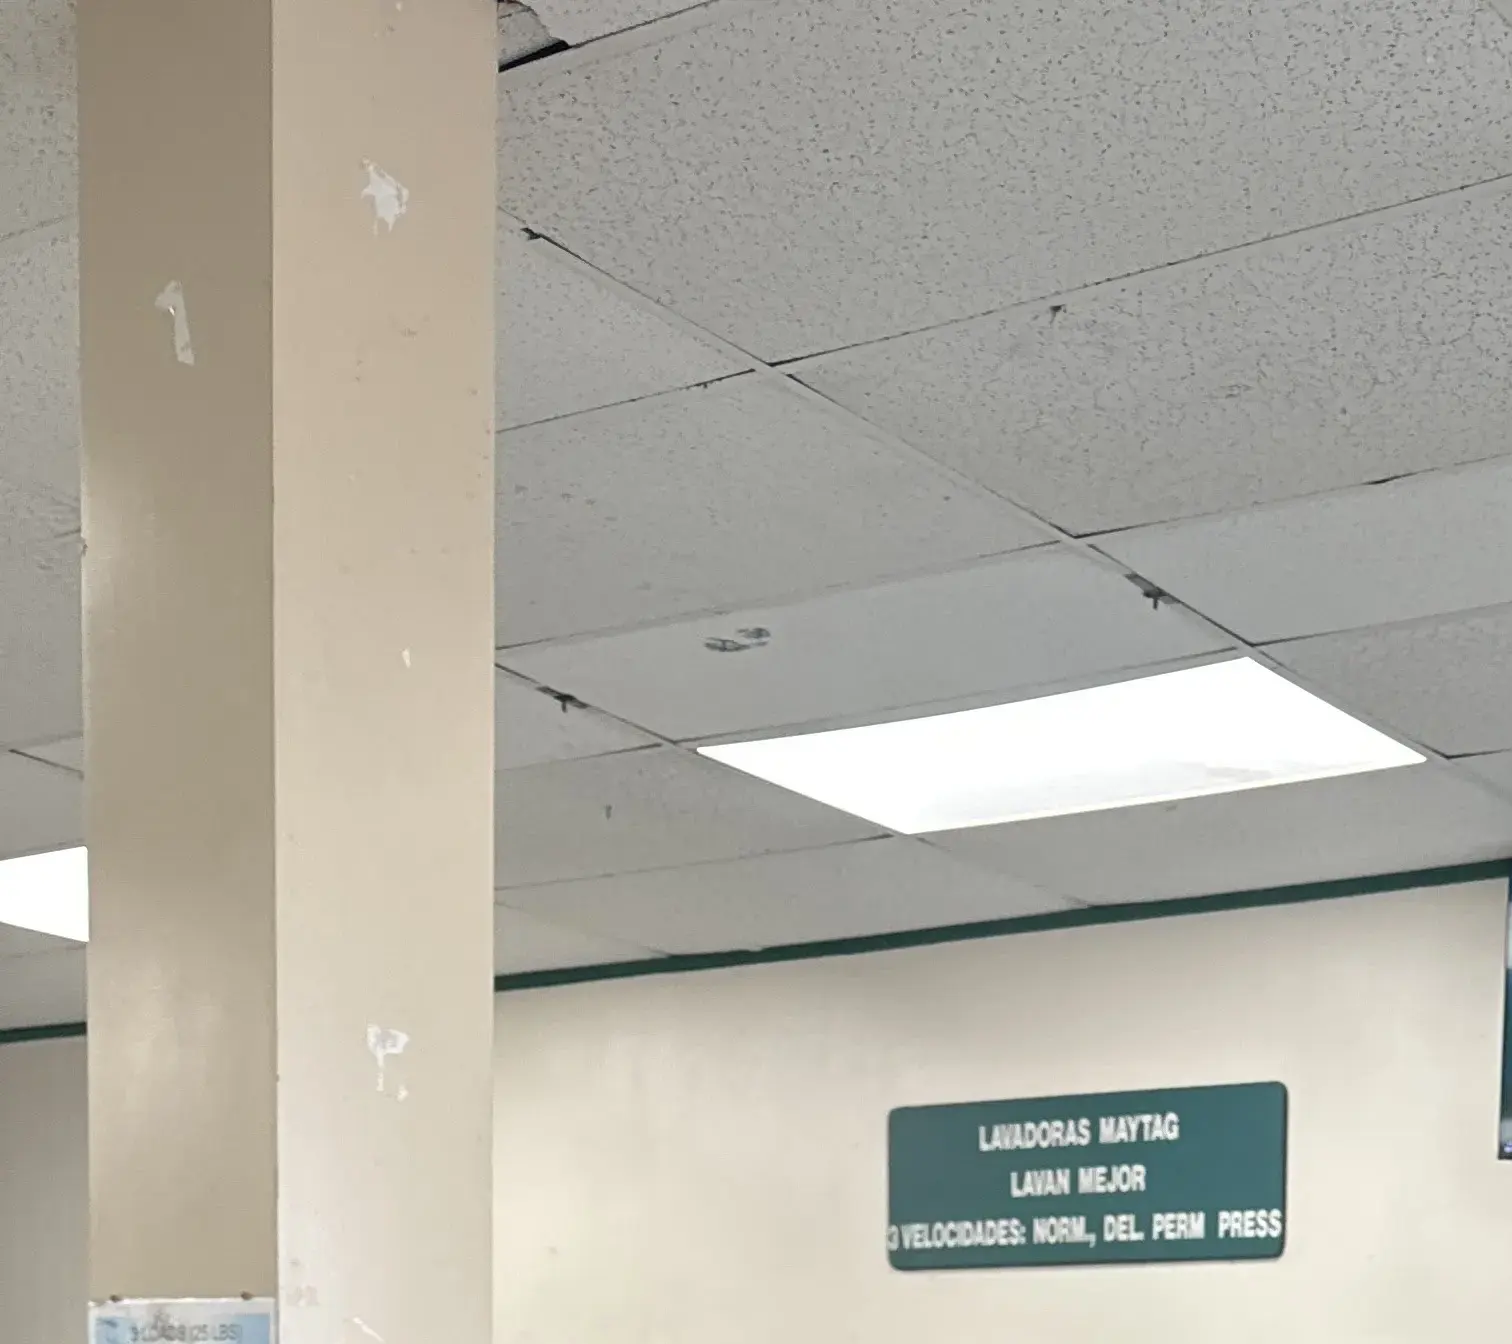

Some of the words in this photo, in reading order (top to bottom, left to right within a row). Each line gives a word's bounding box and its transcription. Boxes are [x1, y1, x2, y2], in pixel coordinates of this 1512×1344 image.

[979, 1117, 1090, 1152] LAVADORAS
[1099, 1112, 1180, 1145] MAYTAG
[1010, 1168, 1070, 1199] LAVAN
[1078, 1164, 1147, 1194] MEJOR
[902, 1217, 1026, 1250] VELOCIDADES:
[1152, 1211, 1206, 1241] PERM
[1218, 1208, 1282, 1239] PRESS
